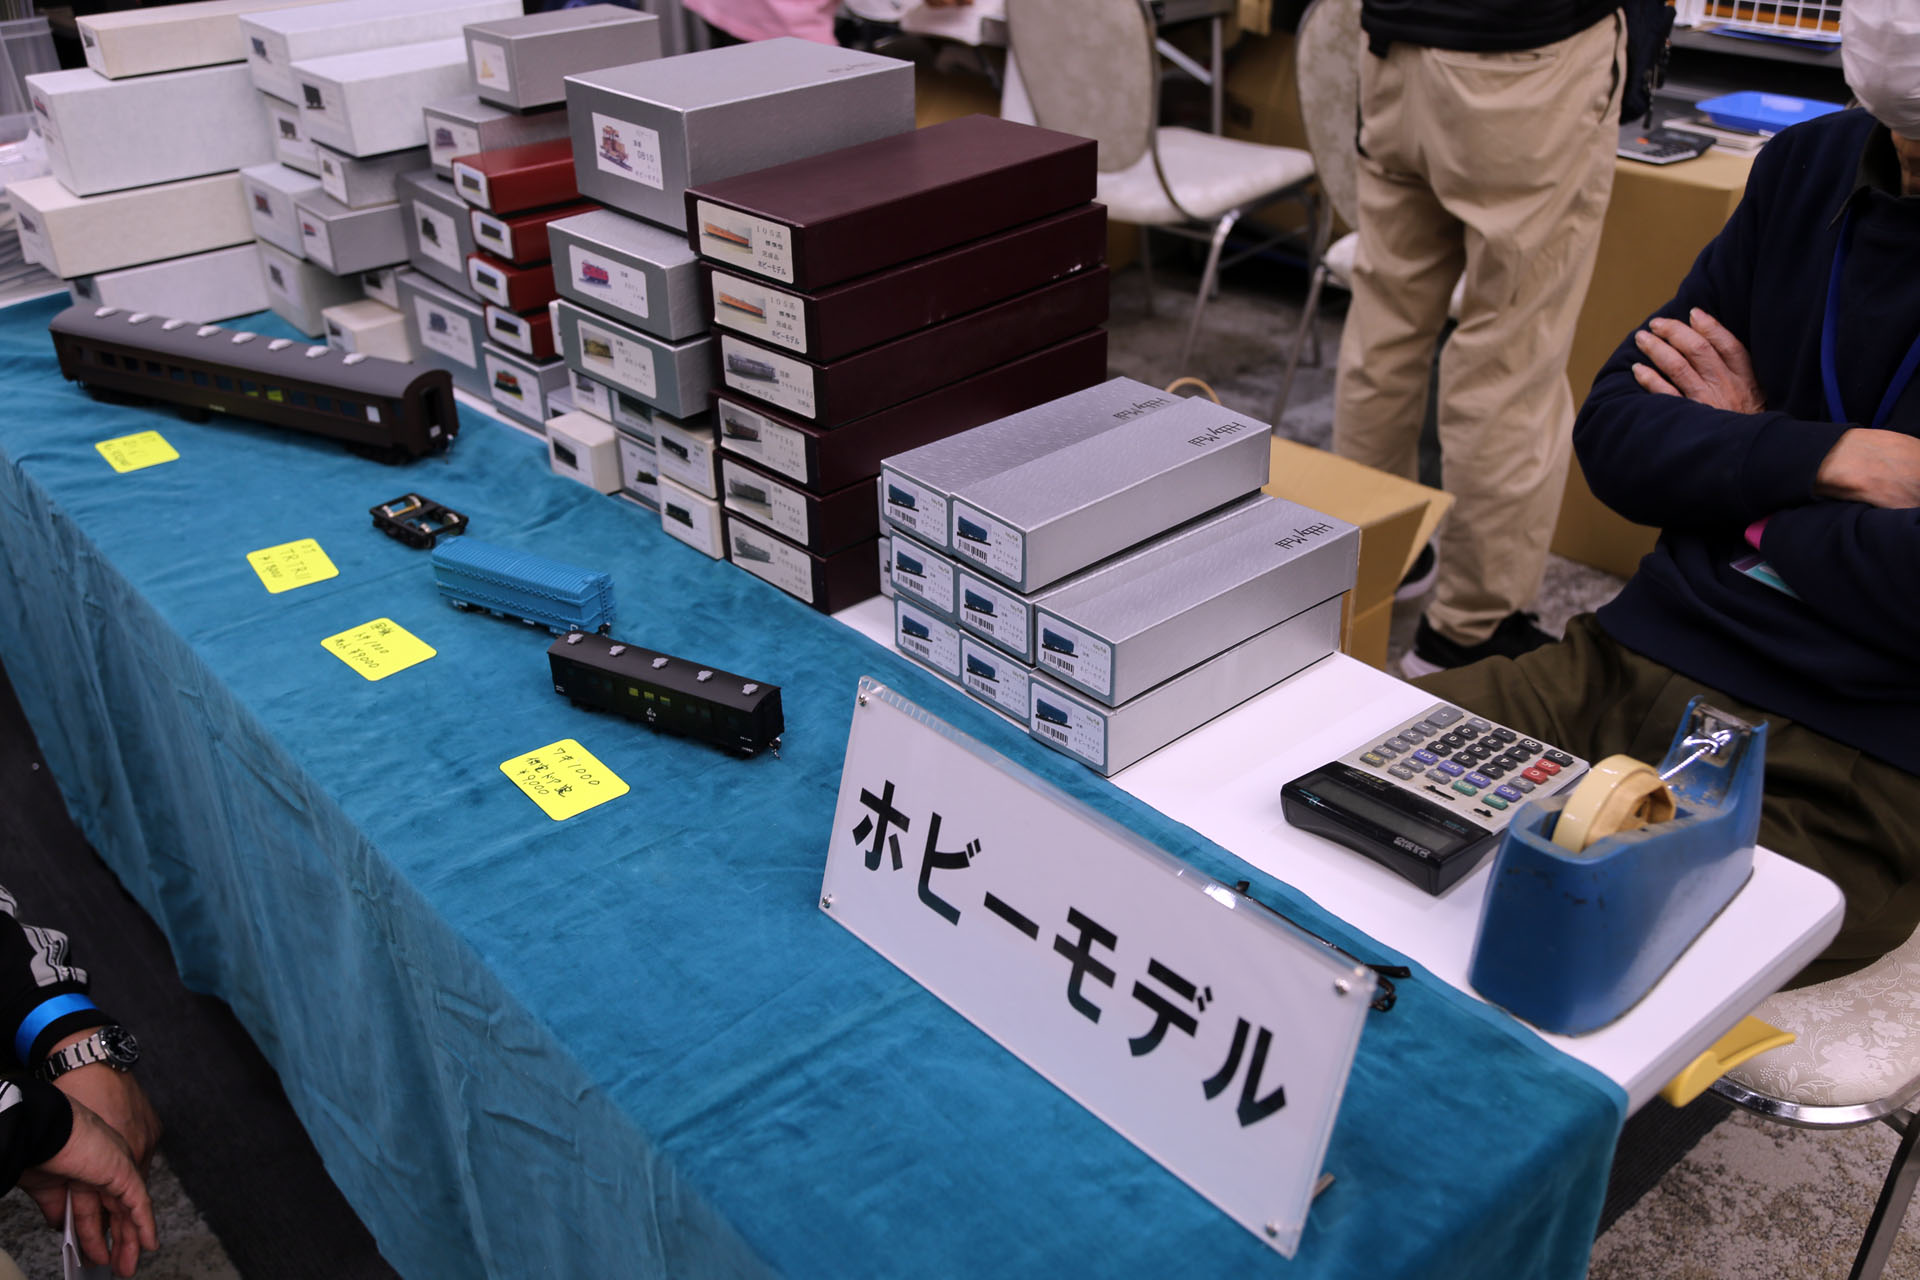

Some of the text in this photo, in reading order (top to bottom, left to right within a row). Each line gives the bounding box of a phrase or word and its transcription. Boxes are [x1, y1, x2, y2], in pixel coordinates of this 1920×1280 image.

[758, 261, 786, 276] ホビーモデル
[772, 330, 800, 346] ホビーモデル
[516, 769, 550, 795] ¥9,000
[852, 779, 1288, 1128] ホビーモデル
